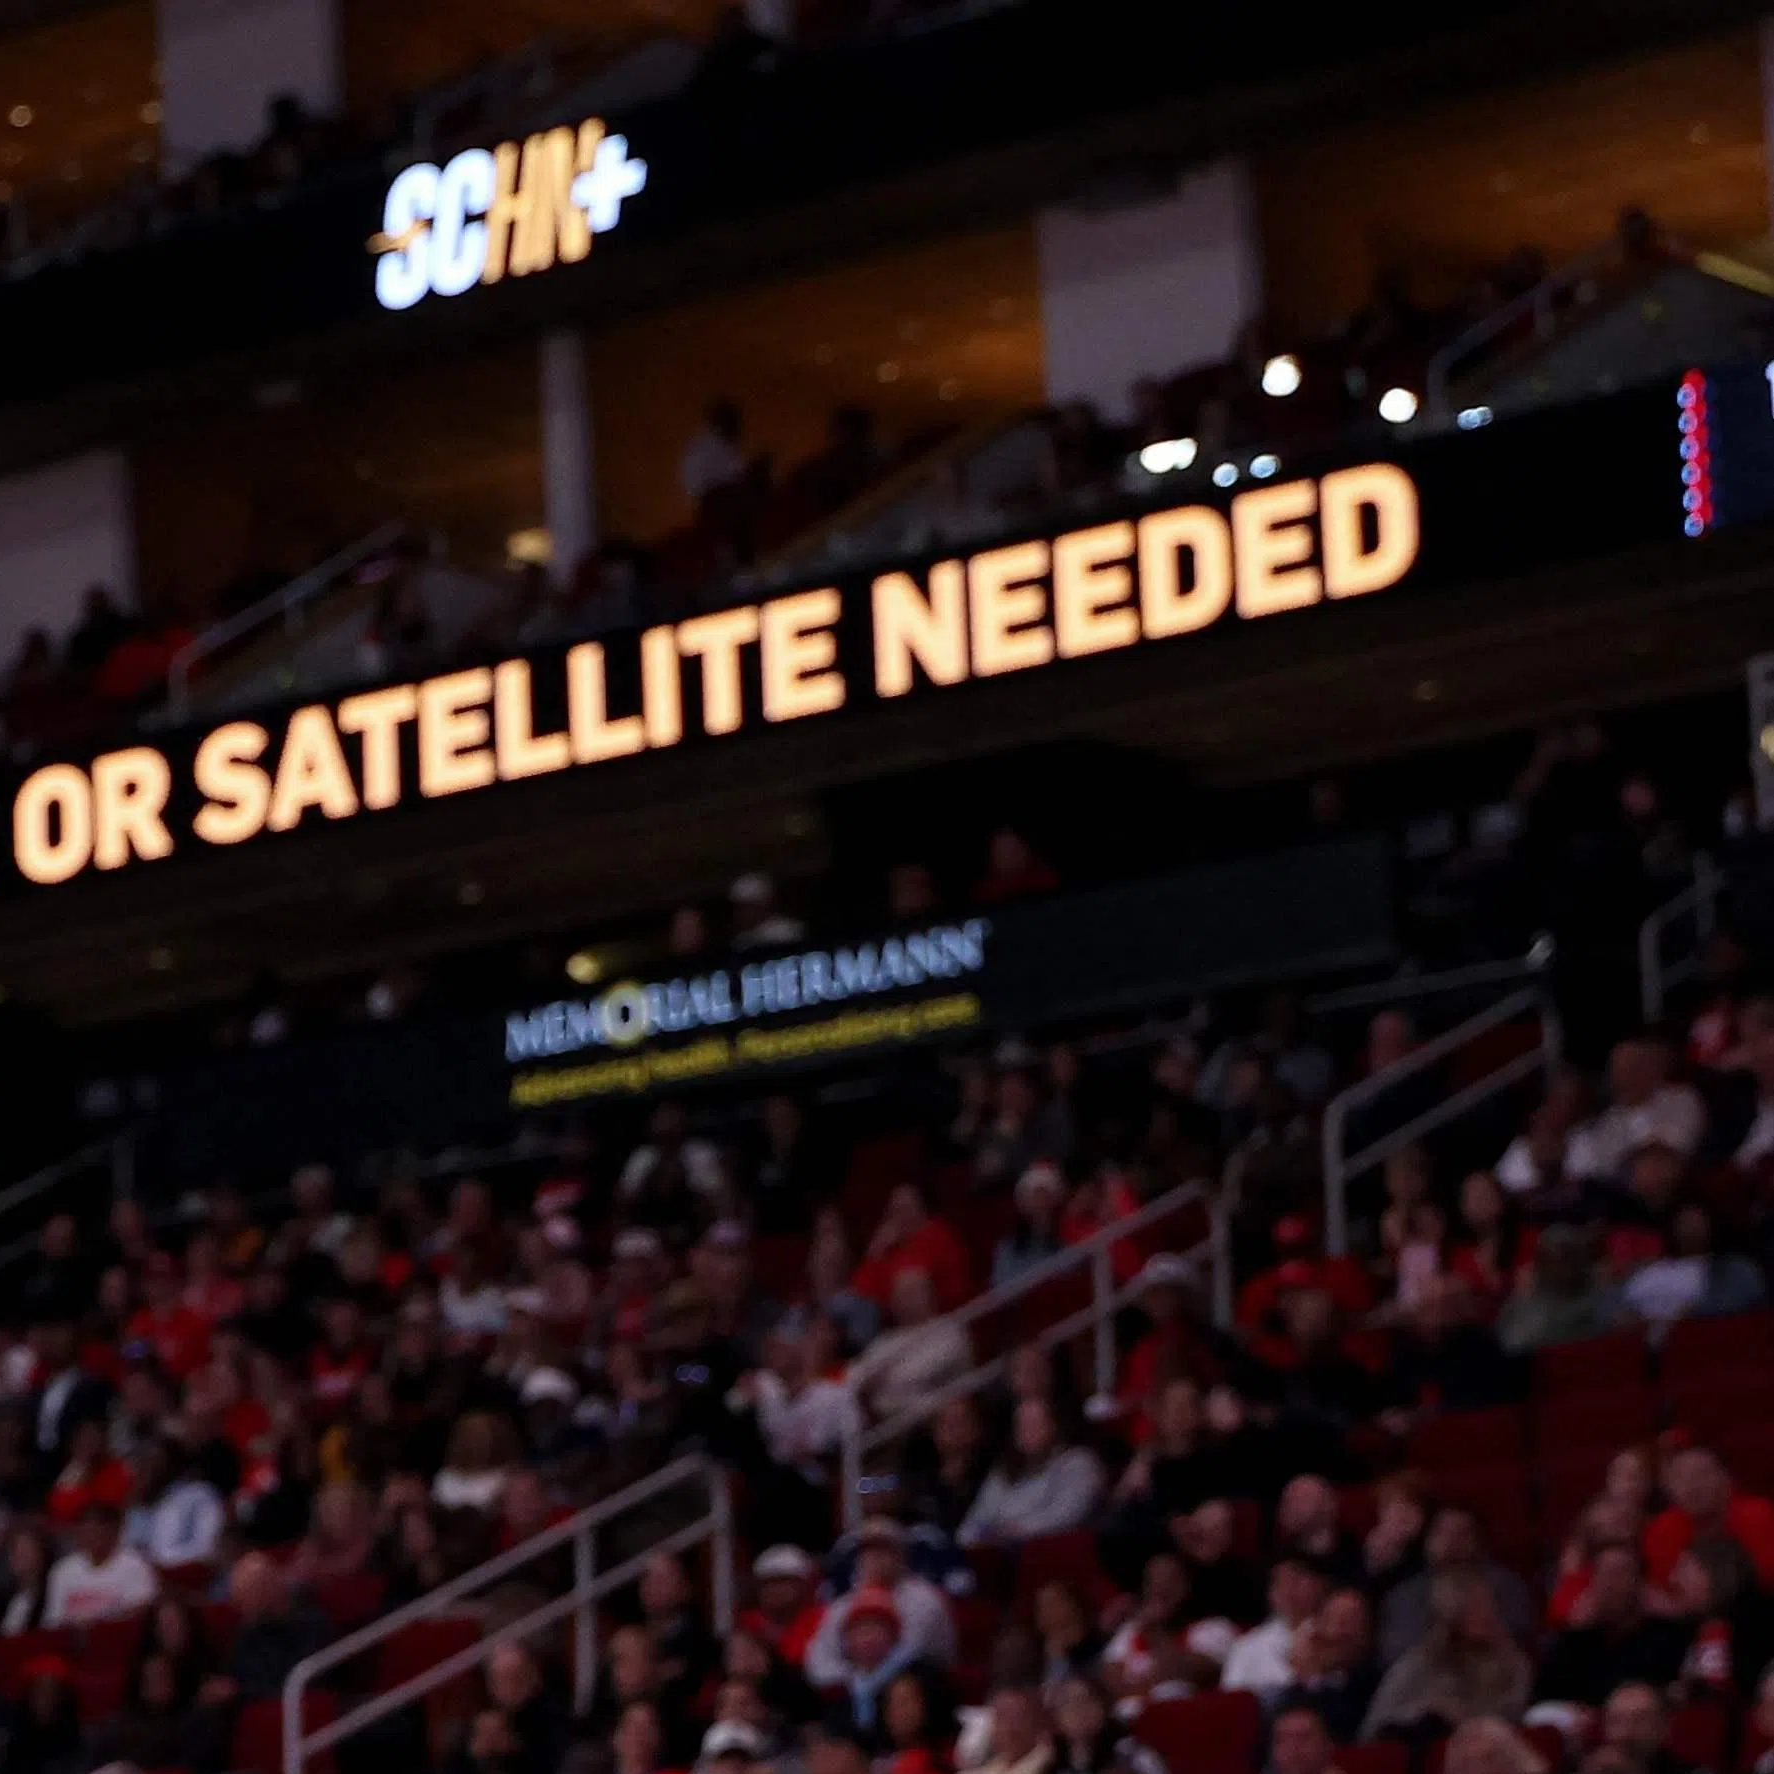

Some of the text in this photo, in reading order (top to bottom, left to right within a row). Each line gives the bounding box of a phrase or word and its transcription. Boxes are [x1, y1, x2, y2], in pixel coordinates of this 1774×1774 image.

[12, 746, 174, 886] OR
[192, 588, 846, 845] SATELLITE
[871, 461, 1421, 699] NEEDED
